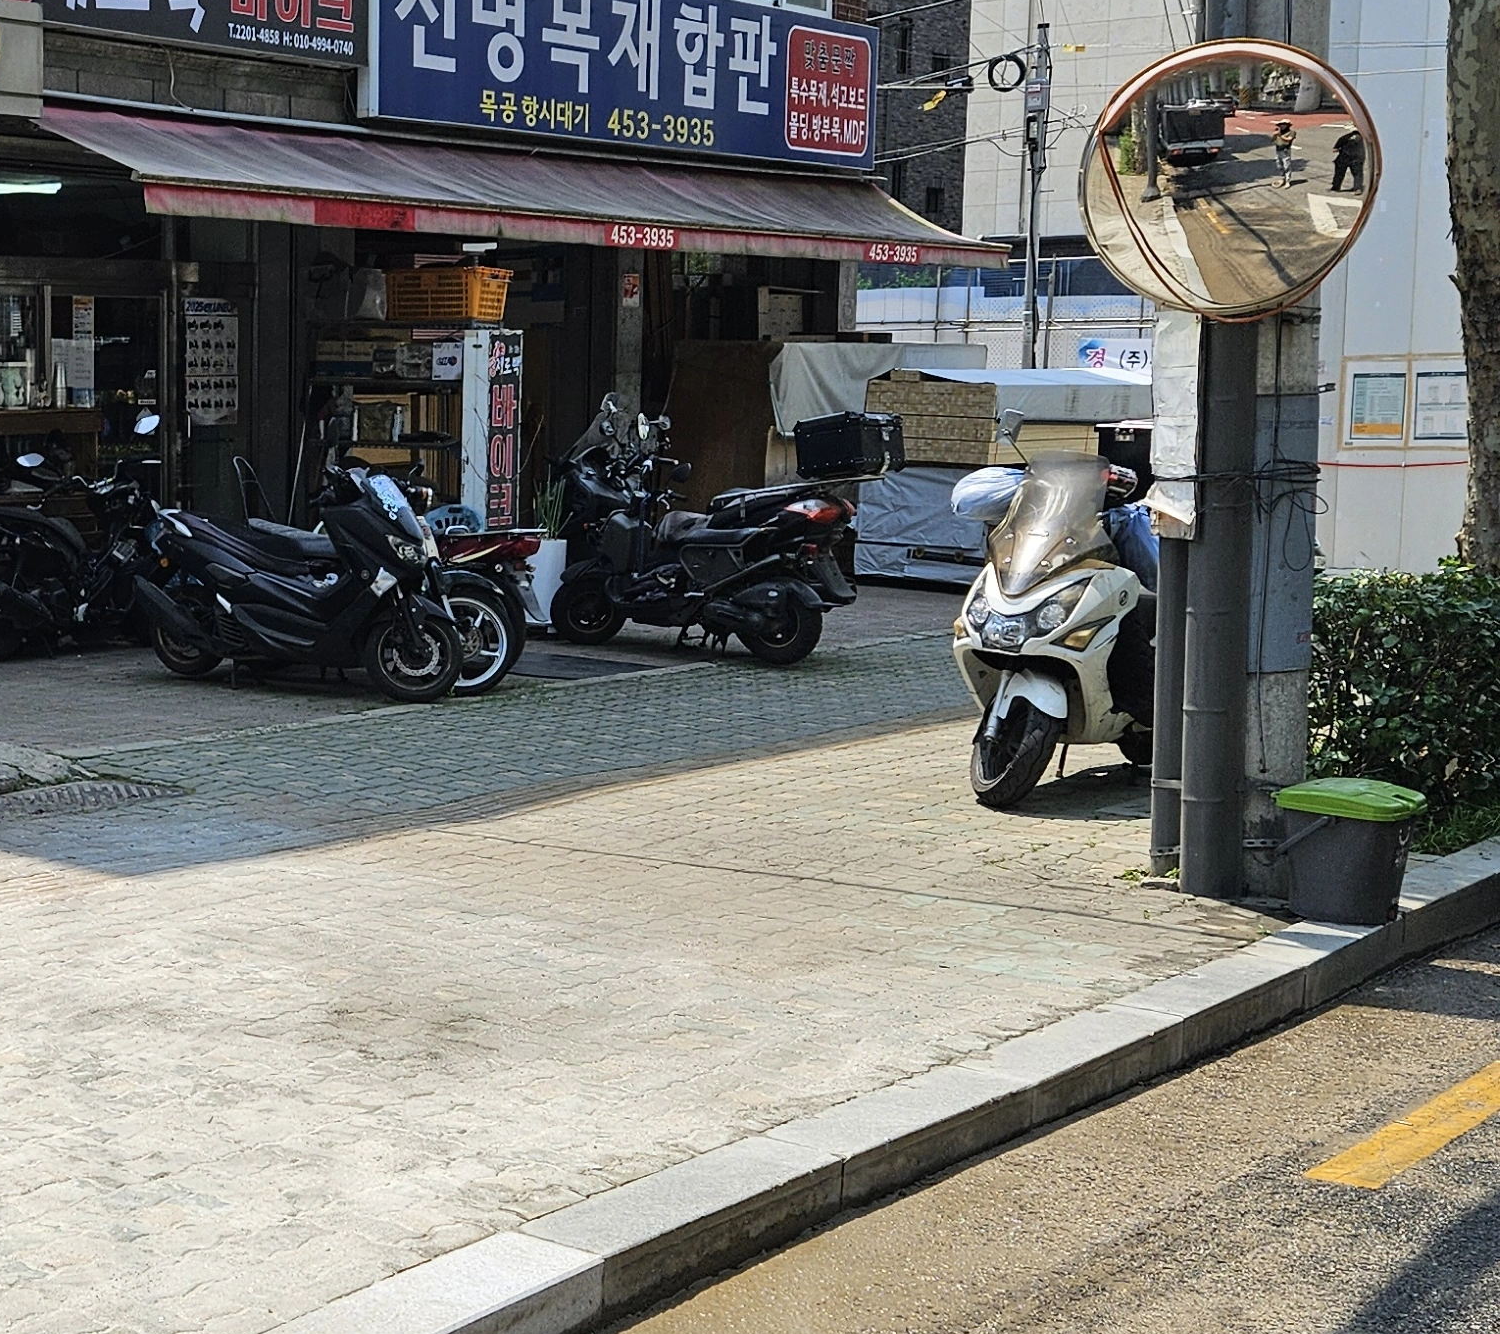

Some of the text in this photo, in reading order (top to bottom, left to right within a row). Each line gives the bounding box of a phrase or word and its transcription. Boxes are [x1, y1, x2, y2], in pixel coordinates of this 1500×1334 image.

[804, 40, 856, 78] 맞춤문짝
[479, 89, 715, 147] 목공 항시대기 453-3935
[610, 225, 675, 249] 453-3935
[868, 243, 918, 264] 453-3935
[1119, 349, 1153, 369] (주)
[489, 383, 518, 528] 바이크
